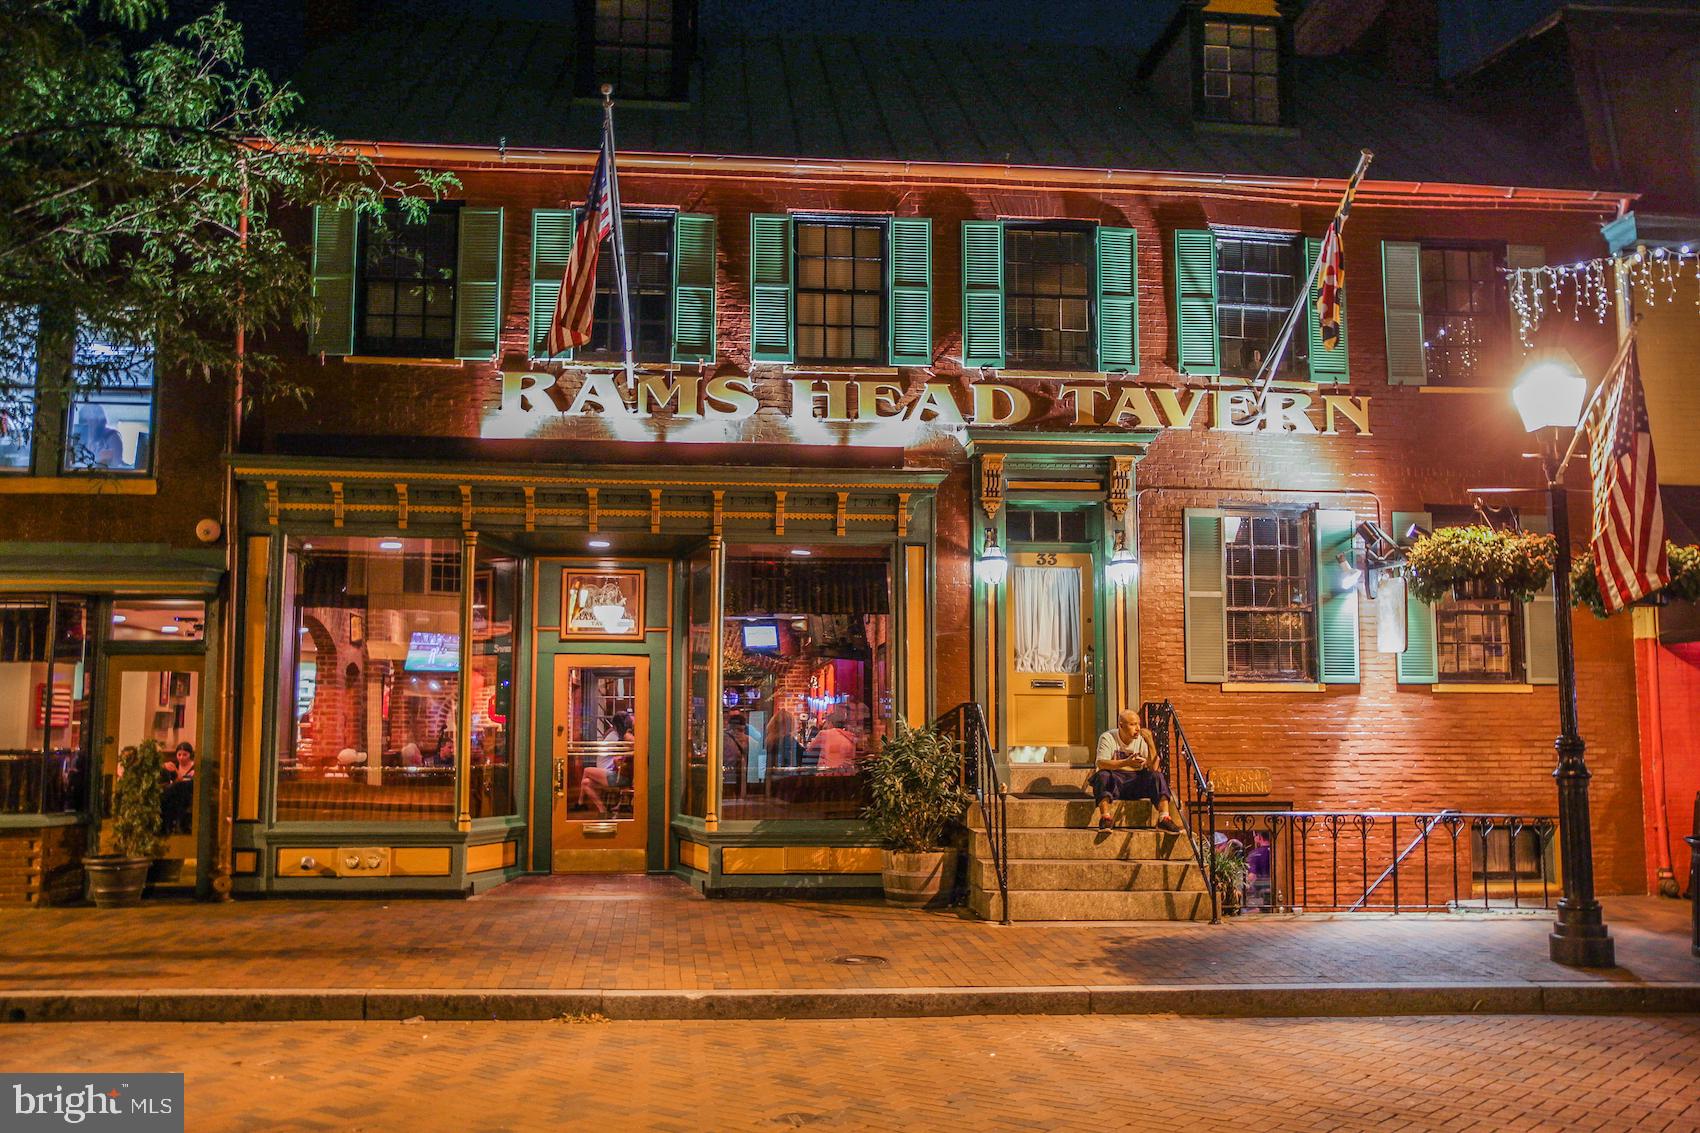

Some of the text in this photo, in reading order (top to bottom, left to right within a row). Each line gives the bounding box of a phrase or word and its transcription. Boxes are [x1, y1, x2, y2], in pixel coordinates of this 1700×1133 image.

[497, 370, 1373, 436] RAMS HEAD TAVERN
[1036, 552, 1057, 566] 33
